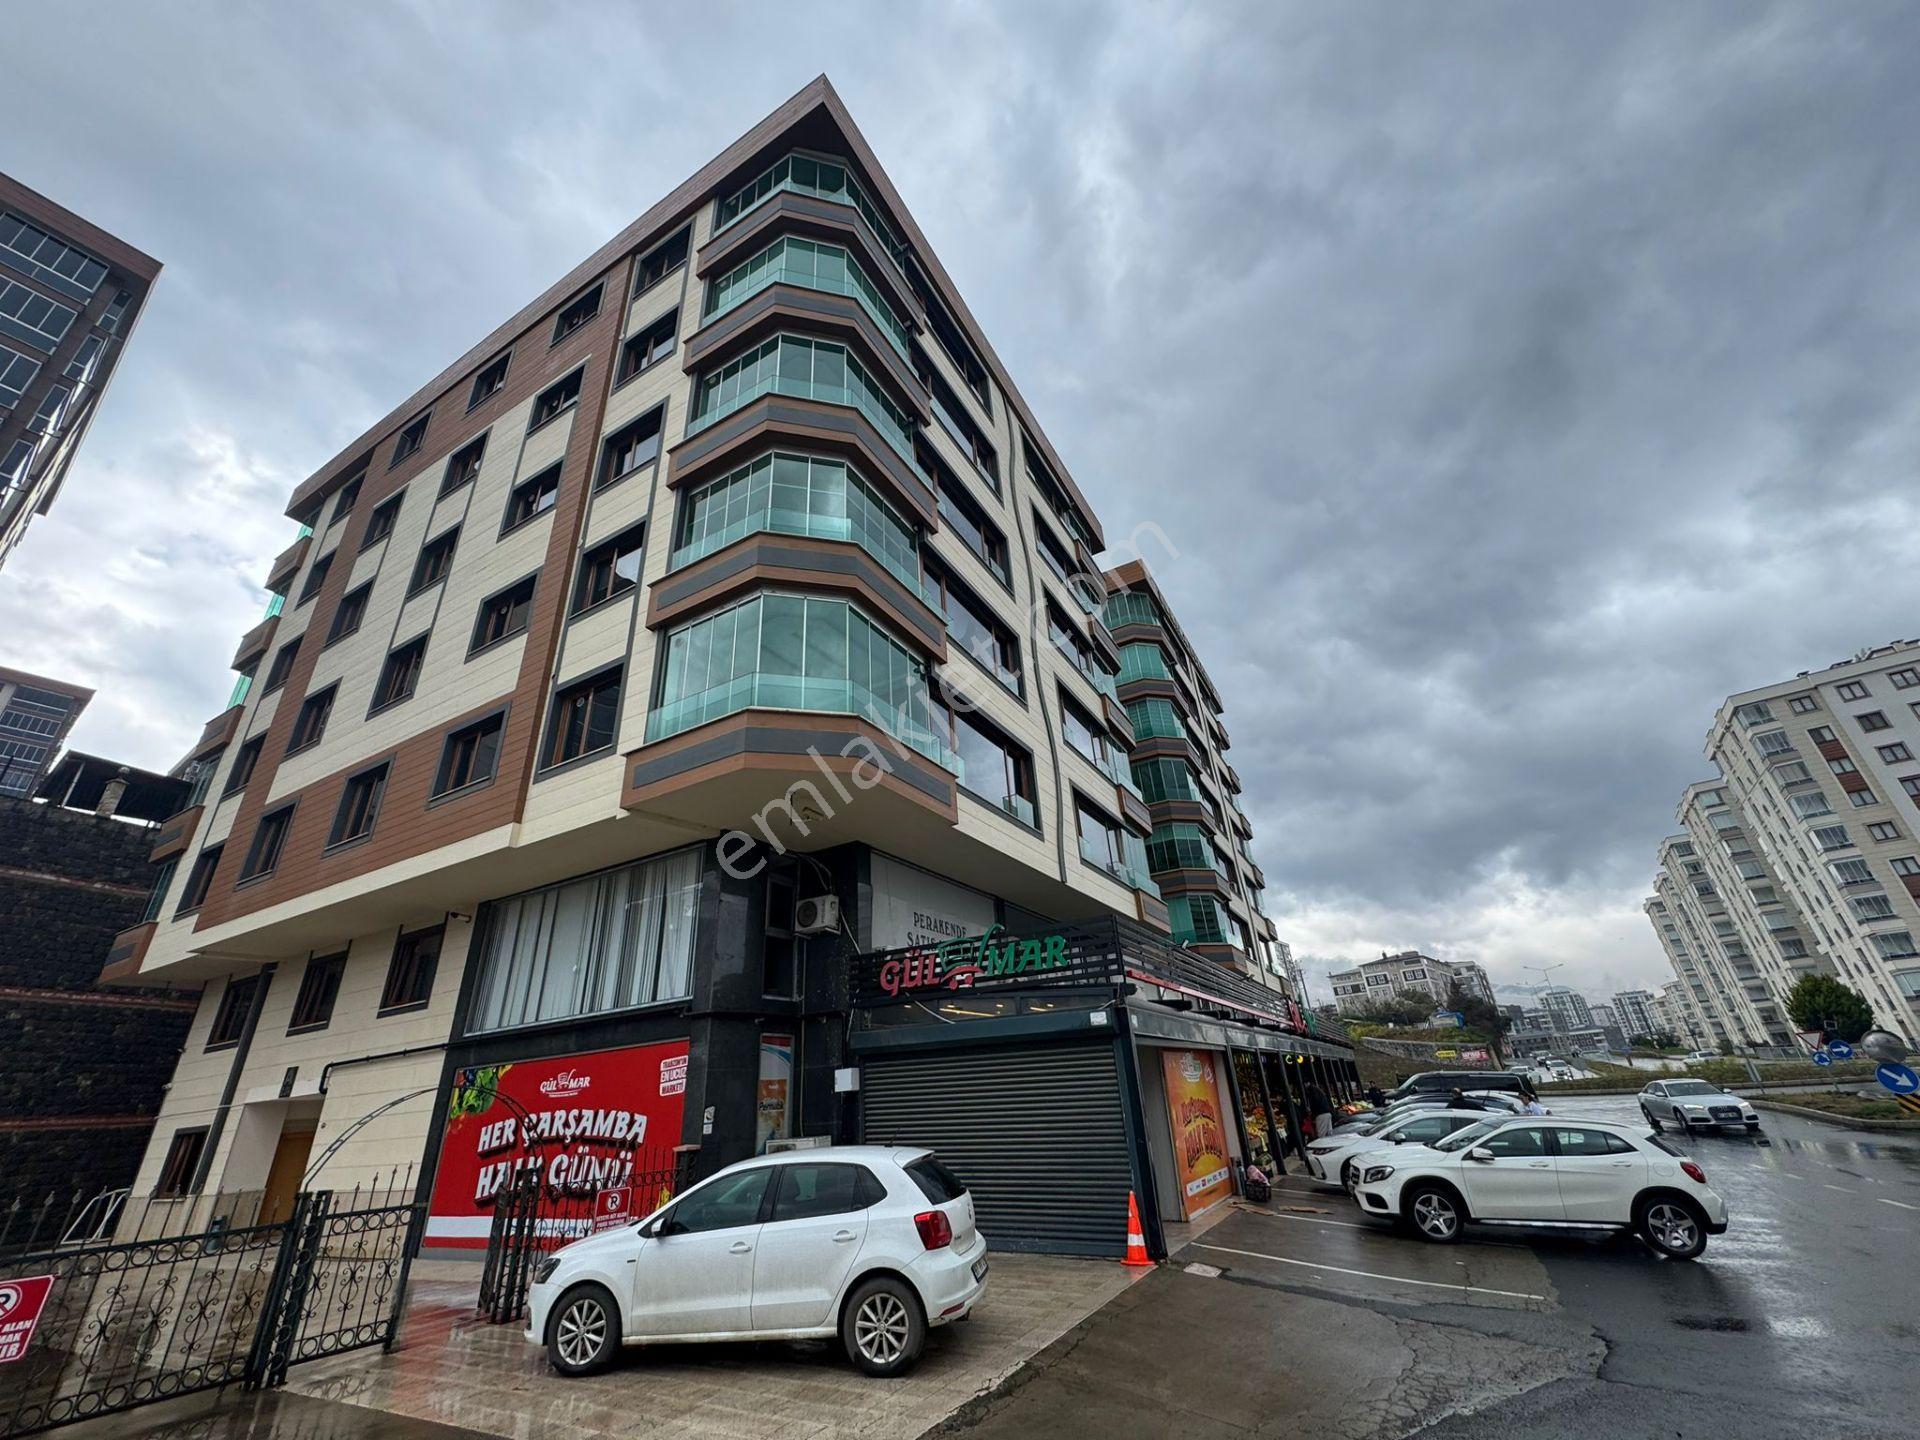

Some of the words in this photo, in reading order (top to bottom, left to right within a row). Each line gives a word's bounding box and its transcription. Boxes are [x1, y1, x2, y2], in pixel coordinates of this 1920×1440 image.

[913, 912, 968, 938] PERAKENDE
[880, 949, 941, 998] GÜL
[985, 935, 1070, 977] MAR
[540, 1078, 557, 1093] GÜL
[568, 1076, 591, 1089] MAR
[477, 1118, 517, 1152] HER
[521, 1109, 648, 1147] ÇARŞAMBA
